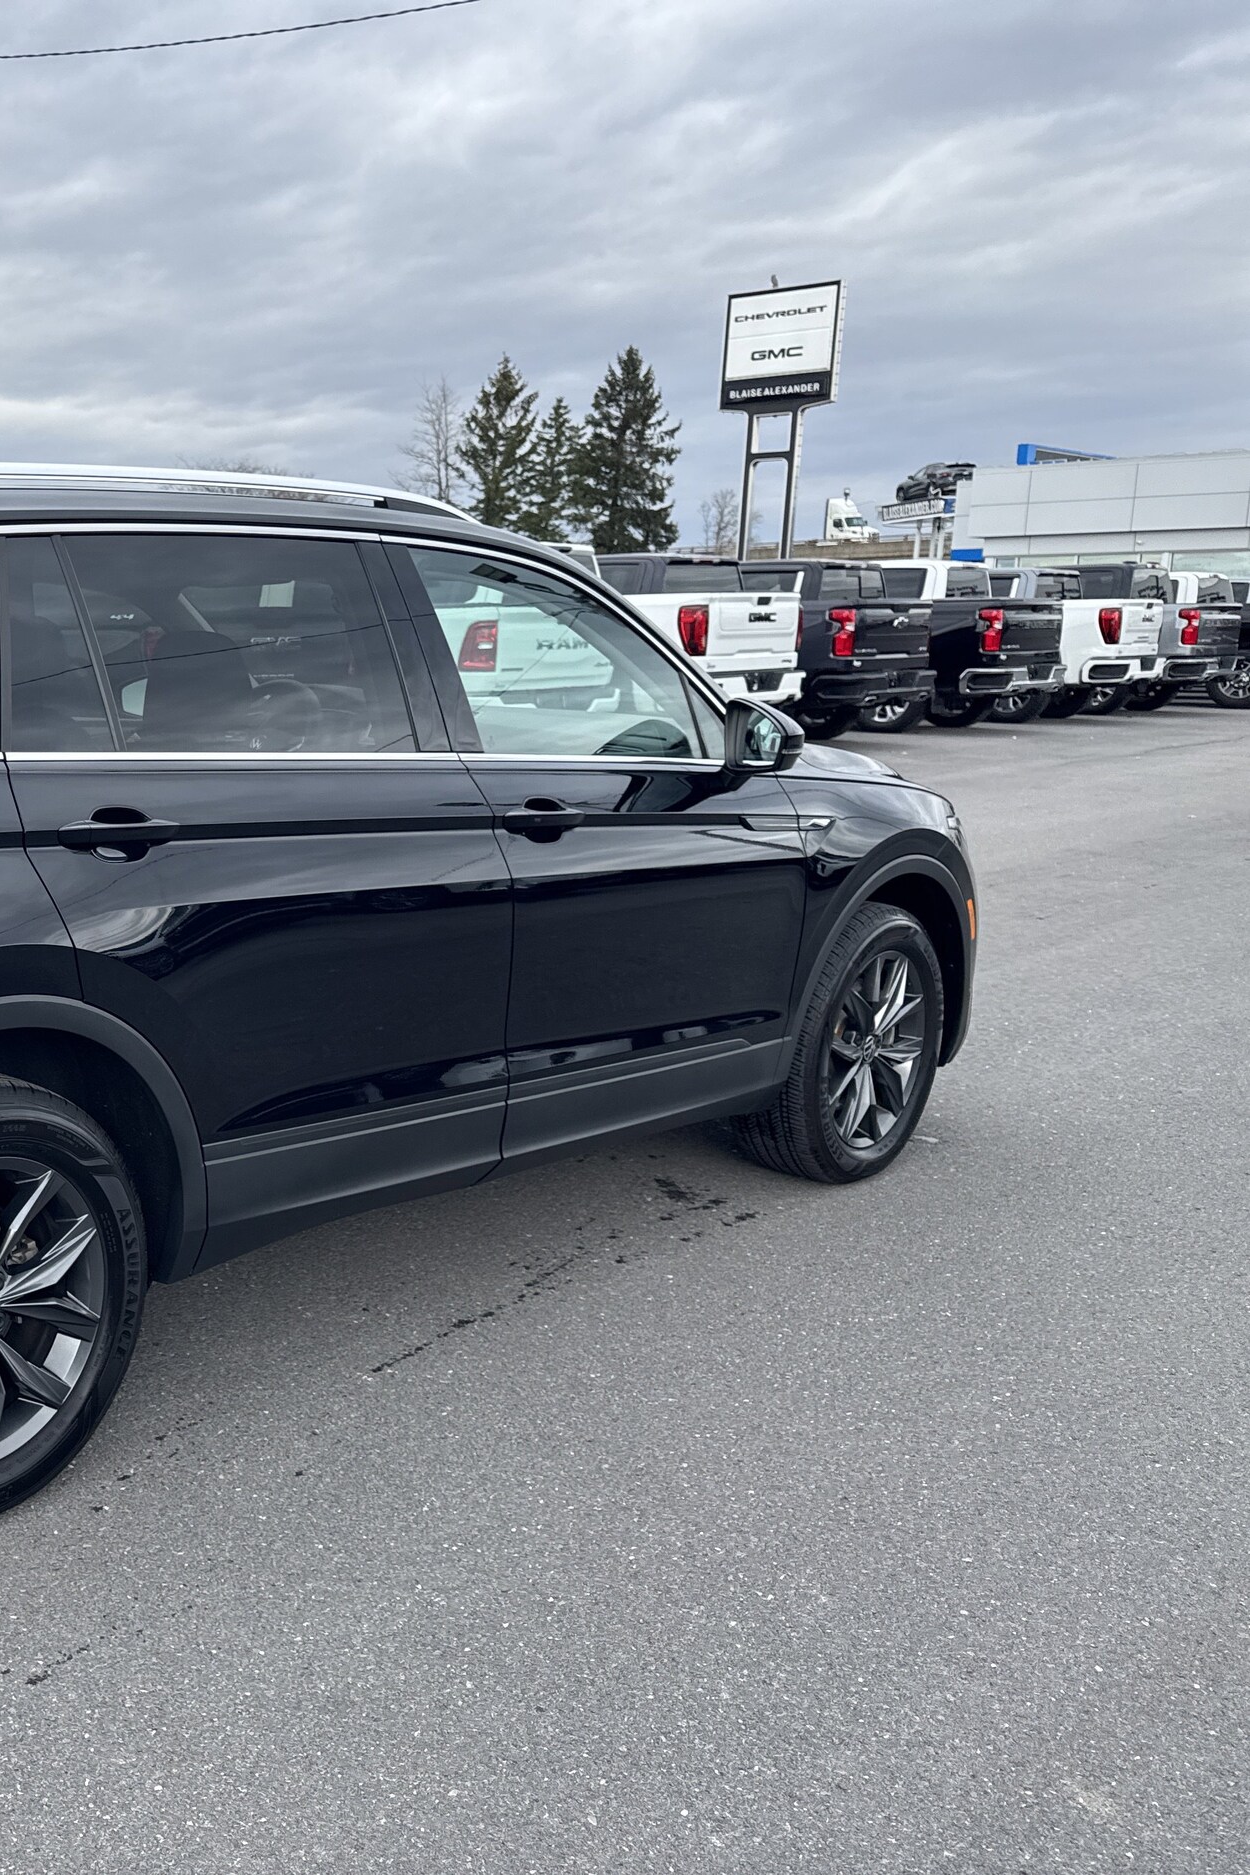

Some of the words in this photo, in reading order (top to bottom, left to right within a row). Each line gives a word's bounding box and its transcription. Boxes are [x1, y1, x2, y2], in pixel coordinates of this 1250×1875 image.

[734, 305, 827, 322] CHEVROLET
[751, 346, 803, 361] GMC
[729, 388, 762, 399] BLAISE
[763, 382, 820, 396] ALEXANDER
[748, 611, 777, 623] GMC
[536, 637, 588, 650] RAM
